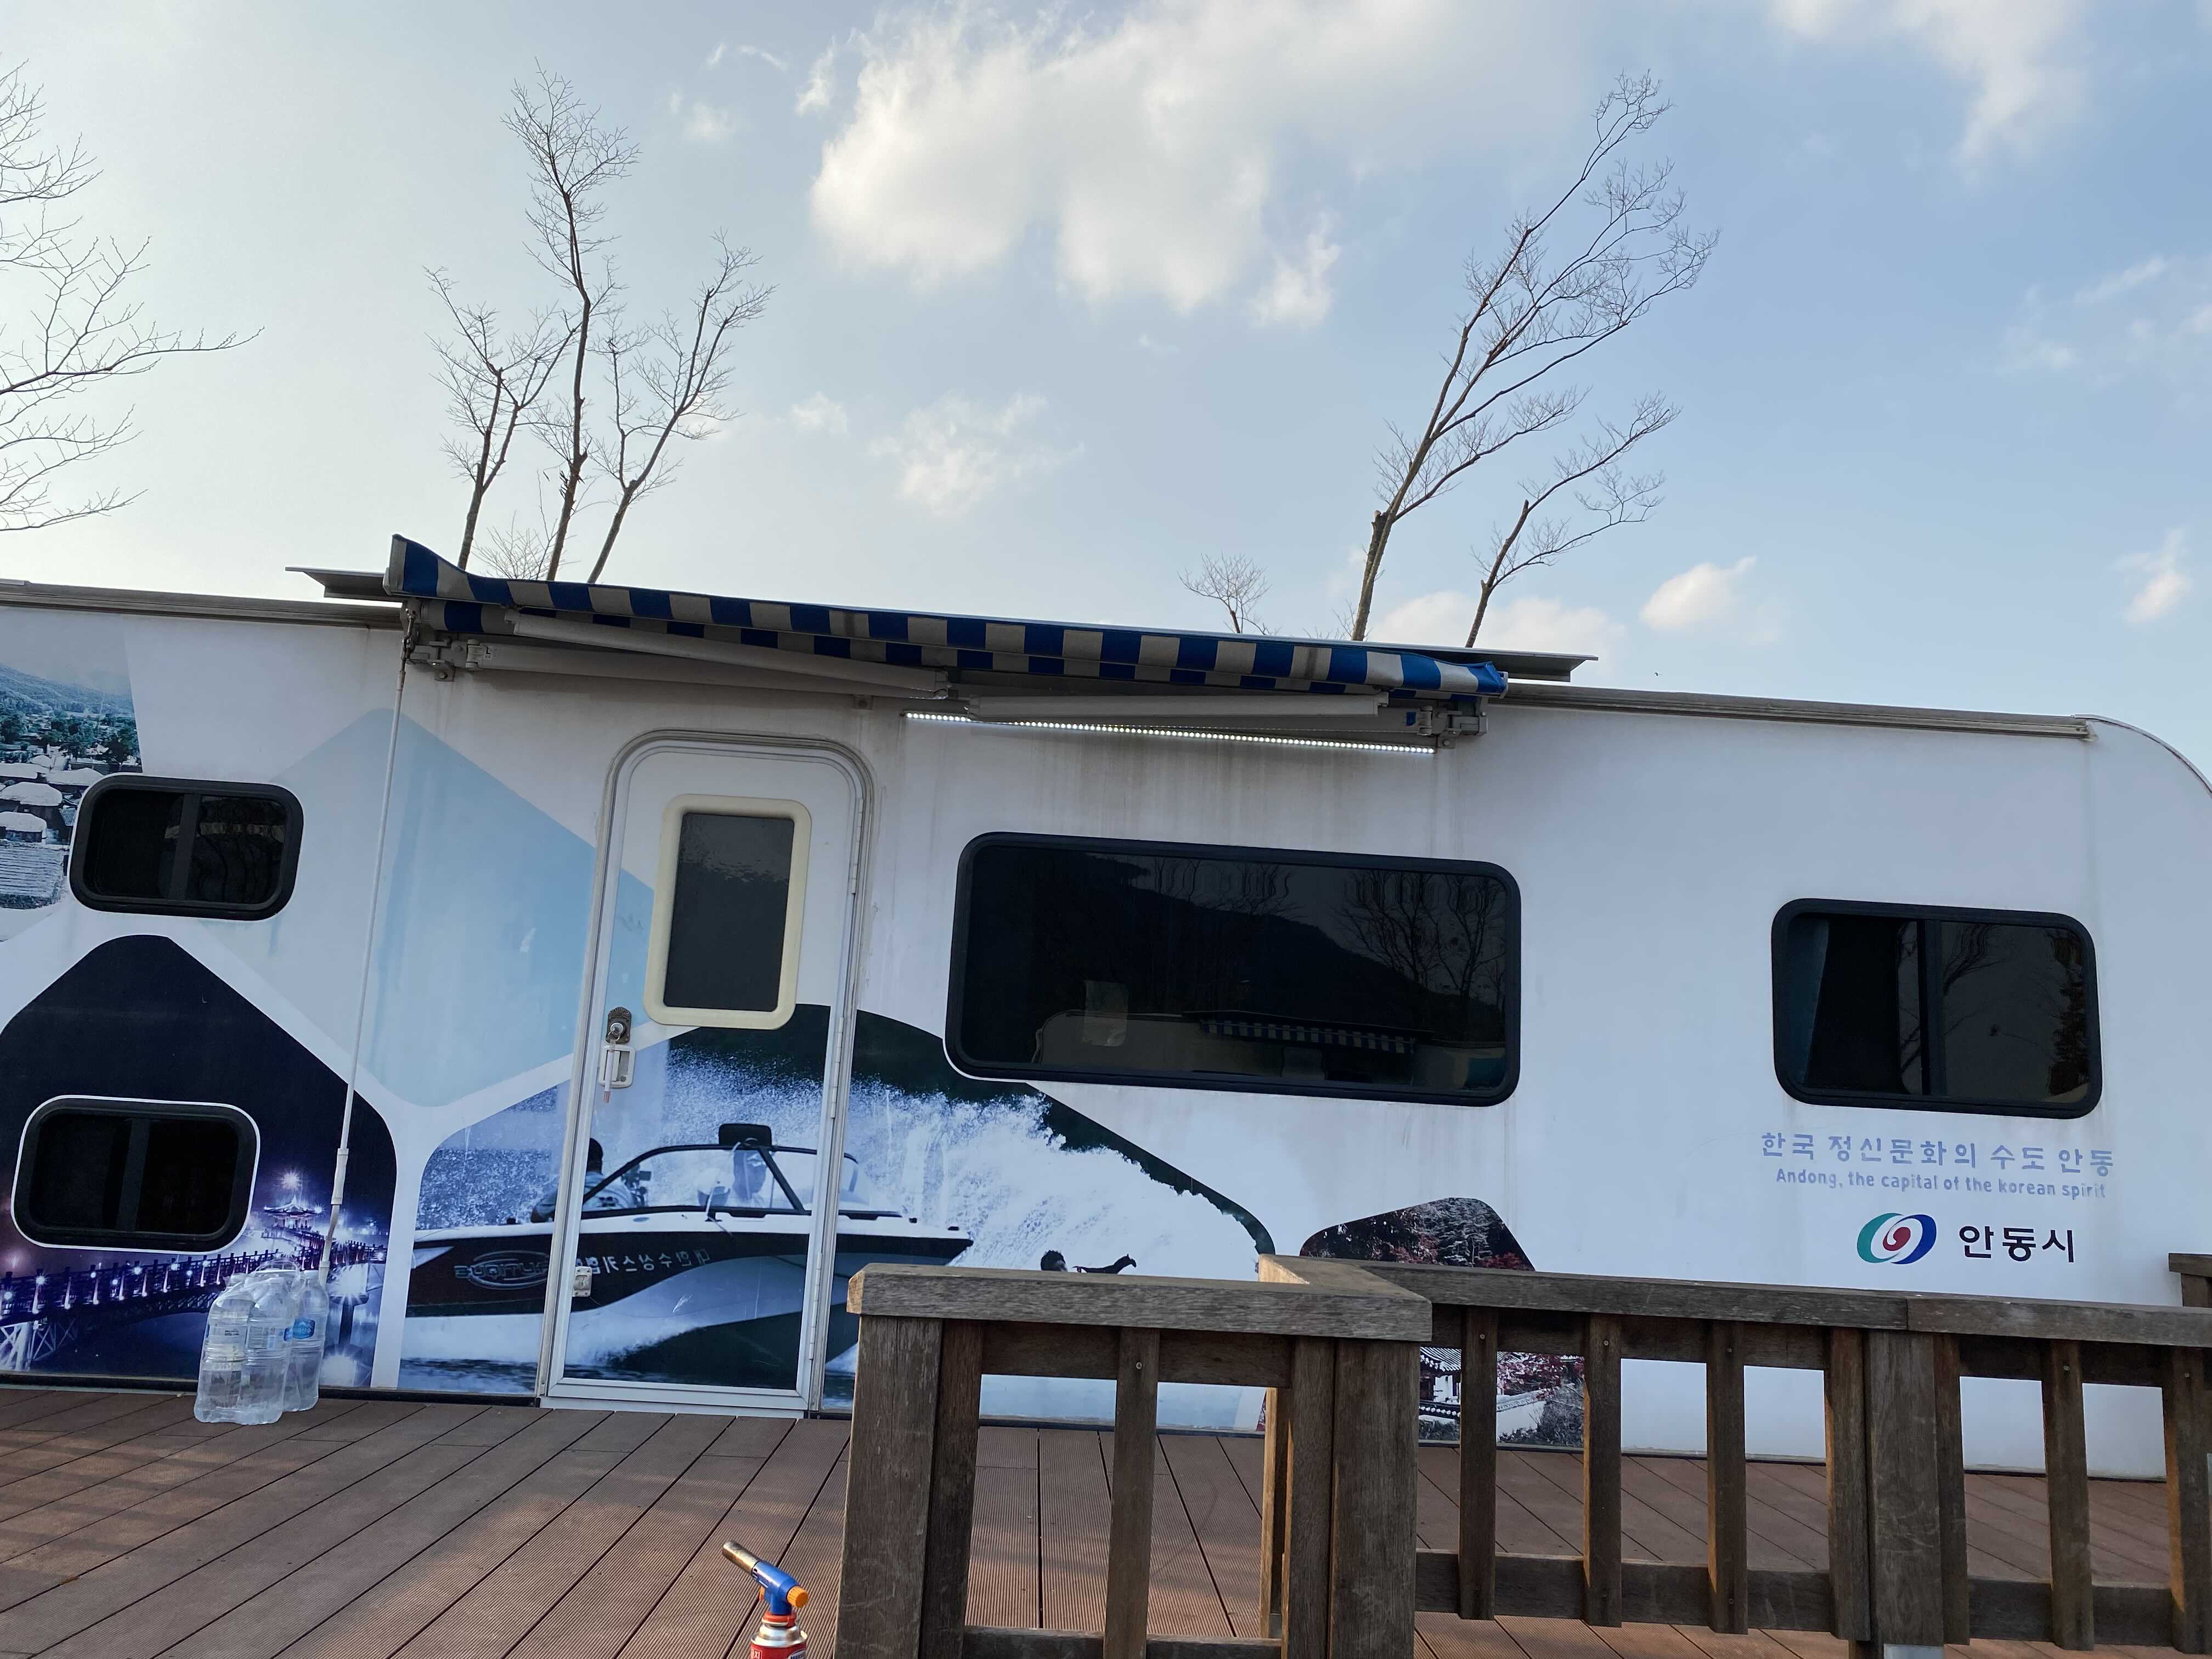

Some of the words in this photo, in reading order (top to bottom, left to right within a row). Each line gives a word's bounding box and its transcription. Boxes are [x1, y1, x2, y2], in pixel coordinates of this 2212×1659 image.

[1761, 1132, 1814, 1160] 한국
[1828, 1135, 1976, 1169] 정신문화의
[1990, 1144, 2045, 1170] 수도
[2058, 1148, 2114, 1177] 안동
[1776, 1168, 1843, 1190] Andong,
[1848, 1171, 1875, 1187] the
[1881, 1174, 1938, 1192] capital
[1943, 1176, 1959, 1192] of
[1965, 1177, 1993, 1194] the
[1998, 1178, 2056, 1196] korean
[2061, 1183, 2106, 1201] spirit
[1958, 1225, 2075, 1263] 안동시
